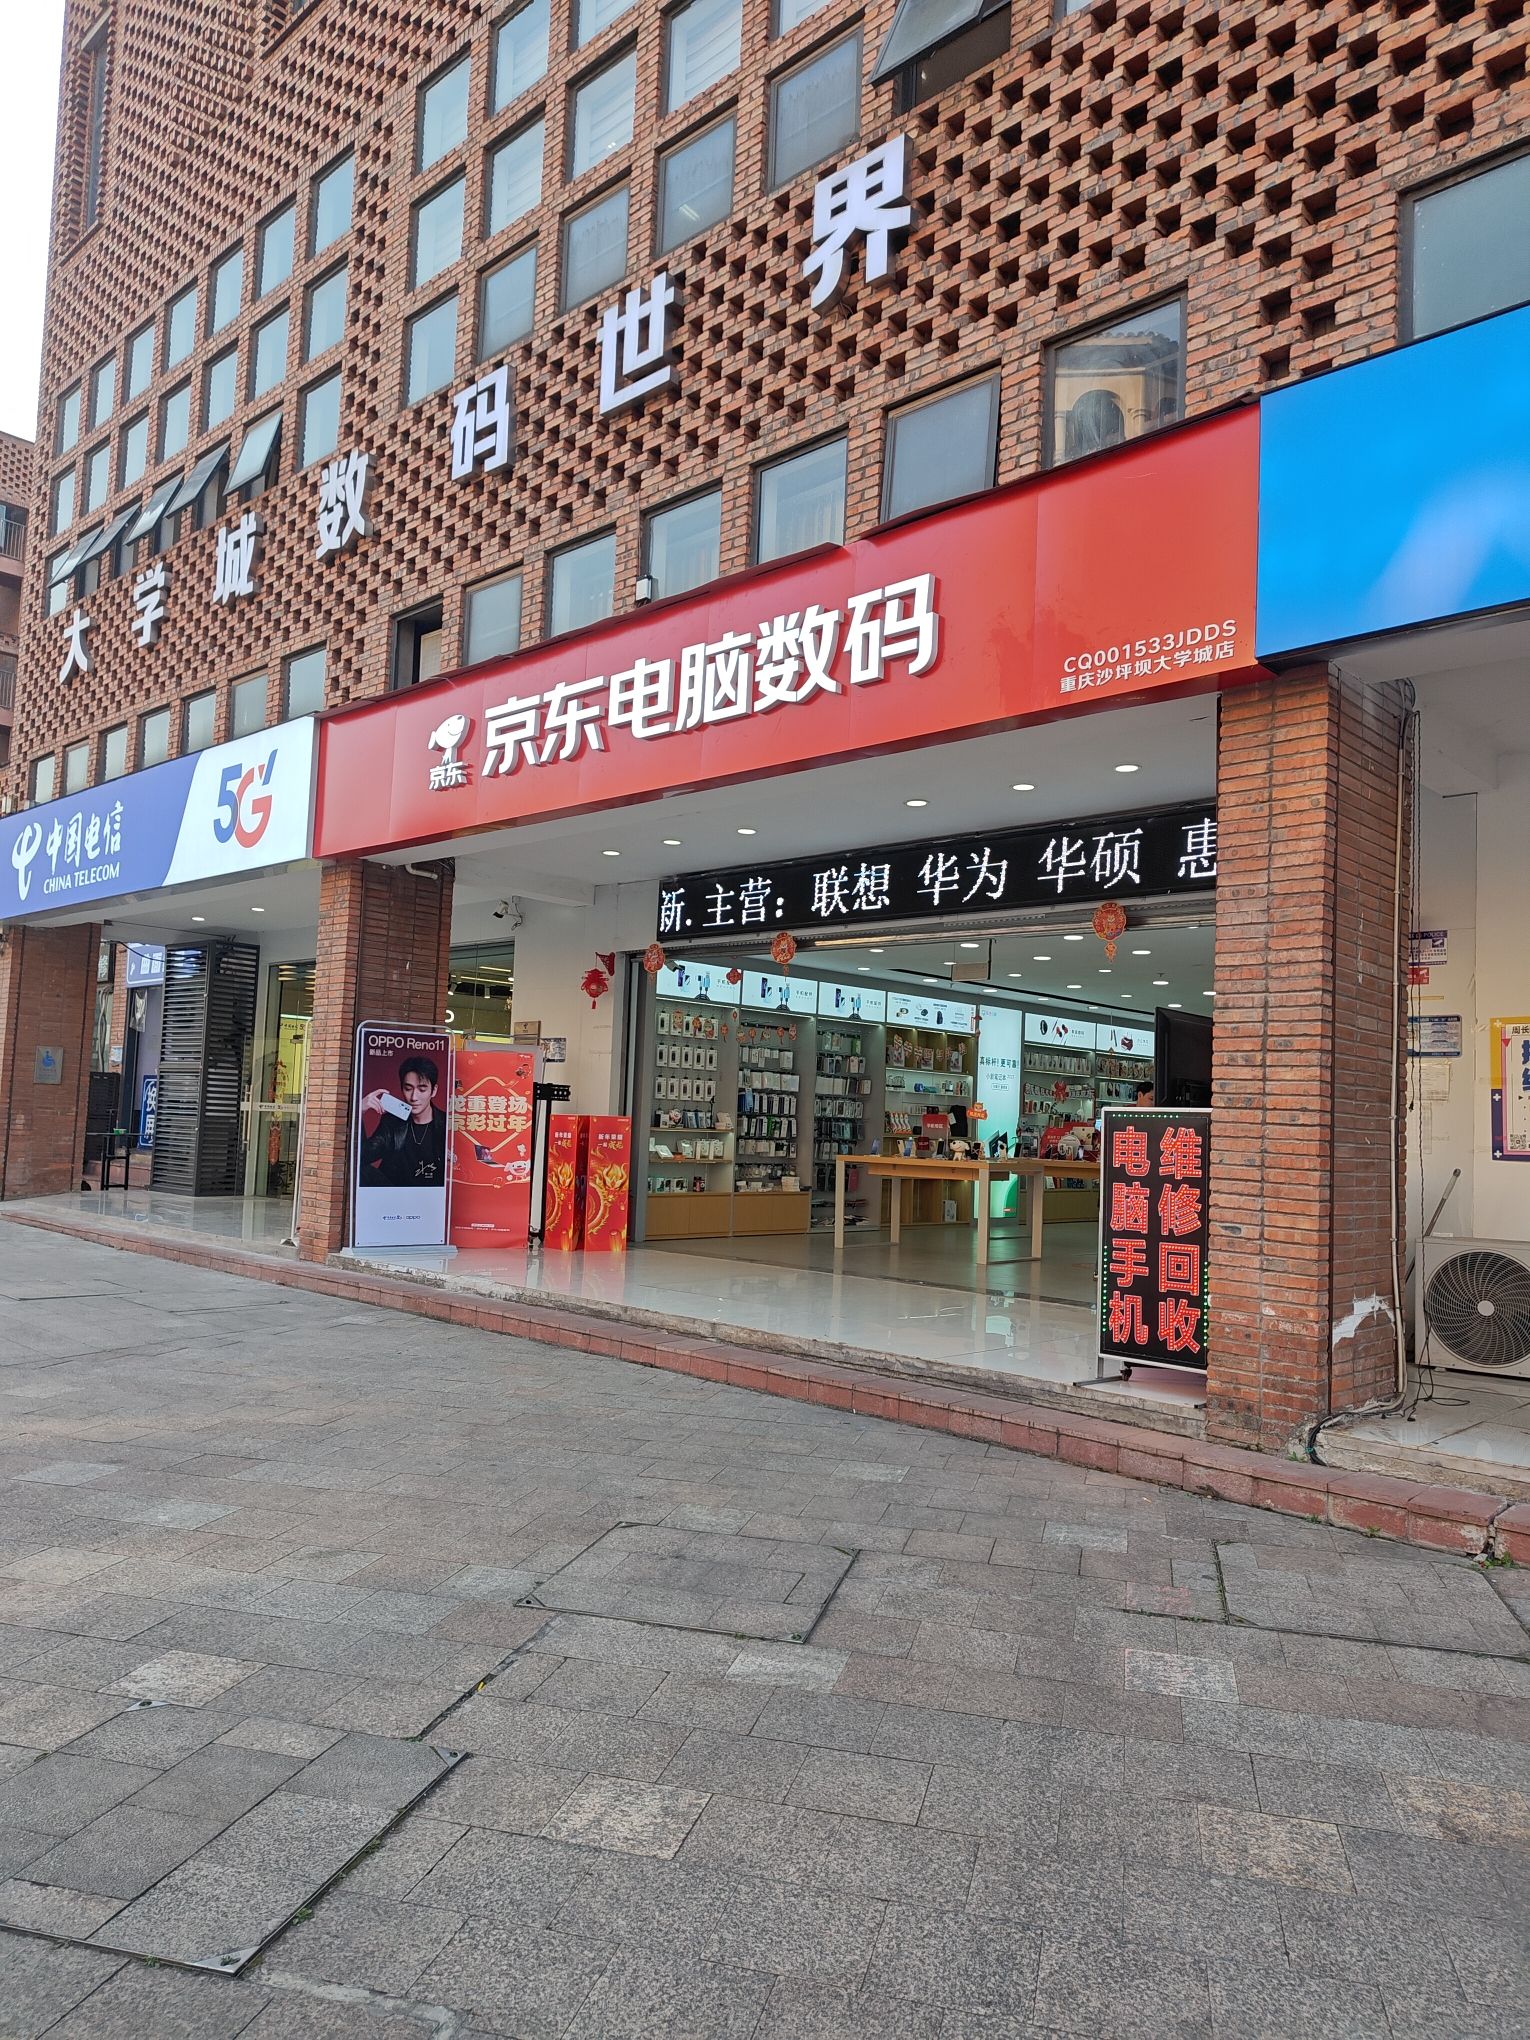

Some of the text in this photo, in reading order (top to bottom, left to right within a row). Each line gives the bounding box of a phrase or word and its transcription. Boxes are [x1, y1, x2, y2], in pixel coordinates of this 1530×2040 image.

[59, 133, 914, 684] 大学城数码世界
[482, 573, 938, 777] 京东电脑数码
[1059, 640, 1236, 694] 重庆沙坪坝大学城店
[1063, 619, 1237, 673] CQ001533JDDS
[213, 750, 277, 849] 5G
[429, 761, 468, 790] 京东
[46, 800, 124, 875] 中国电信
[43, 862, 120, 895] CHINA TELECOM
[811, 862, 891, 917] 联想
[915, 846, 1008, 904] 华为
[1037, 828, 1145, 893] 华硕
[368, 1035, 445, 1051] OPPO Reno11
[448, 1095, 528, 1114] 龙重登场
[448, 1113, 528, 1132] 京彩过年
[1109, 1126, 1151, 1345] 电脑手机
[1158, 1127, 1203, 1354] 维修回收
